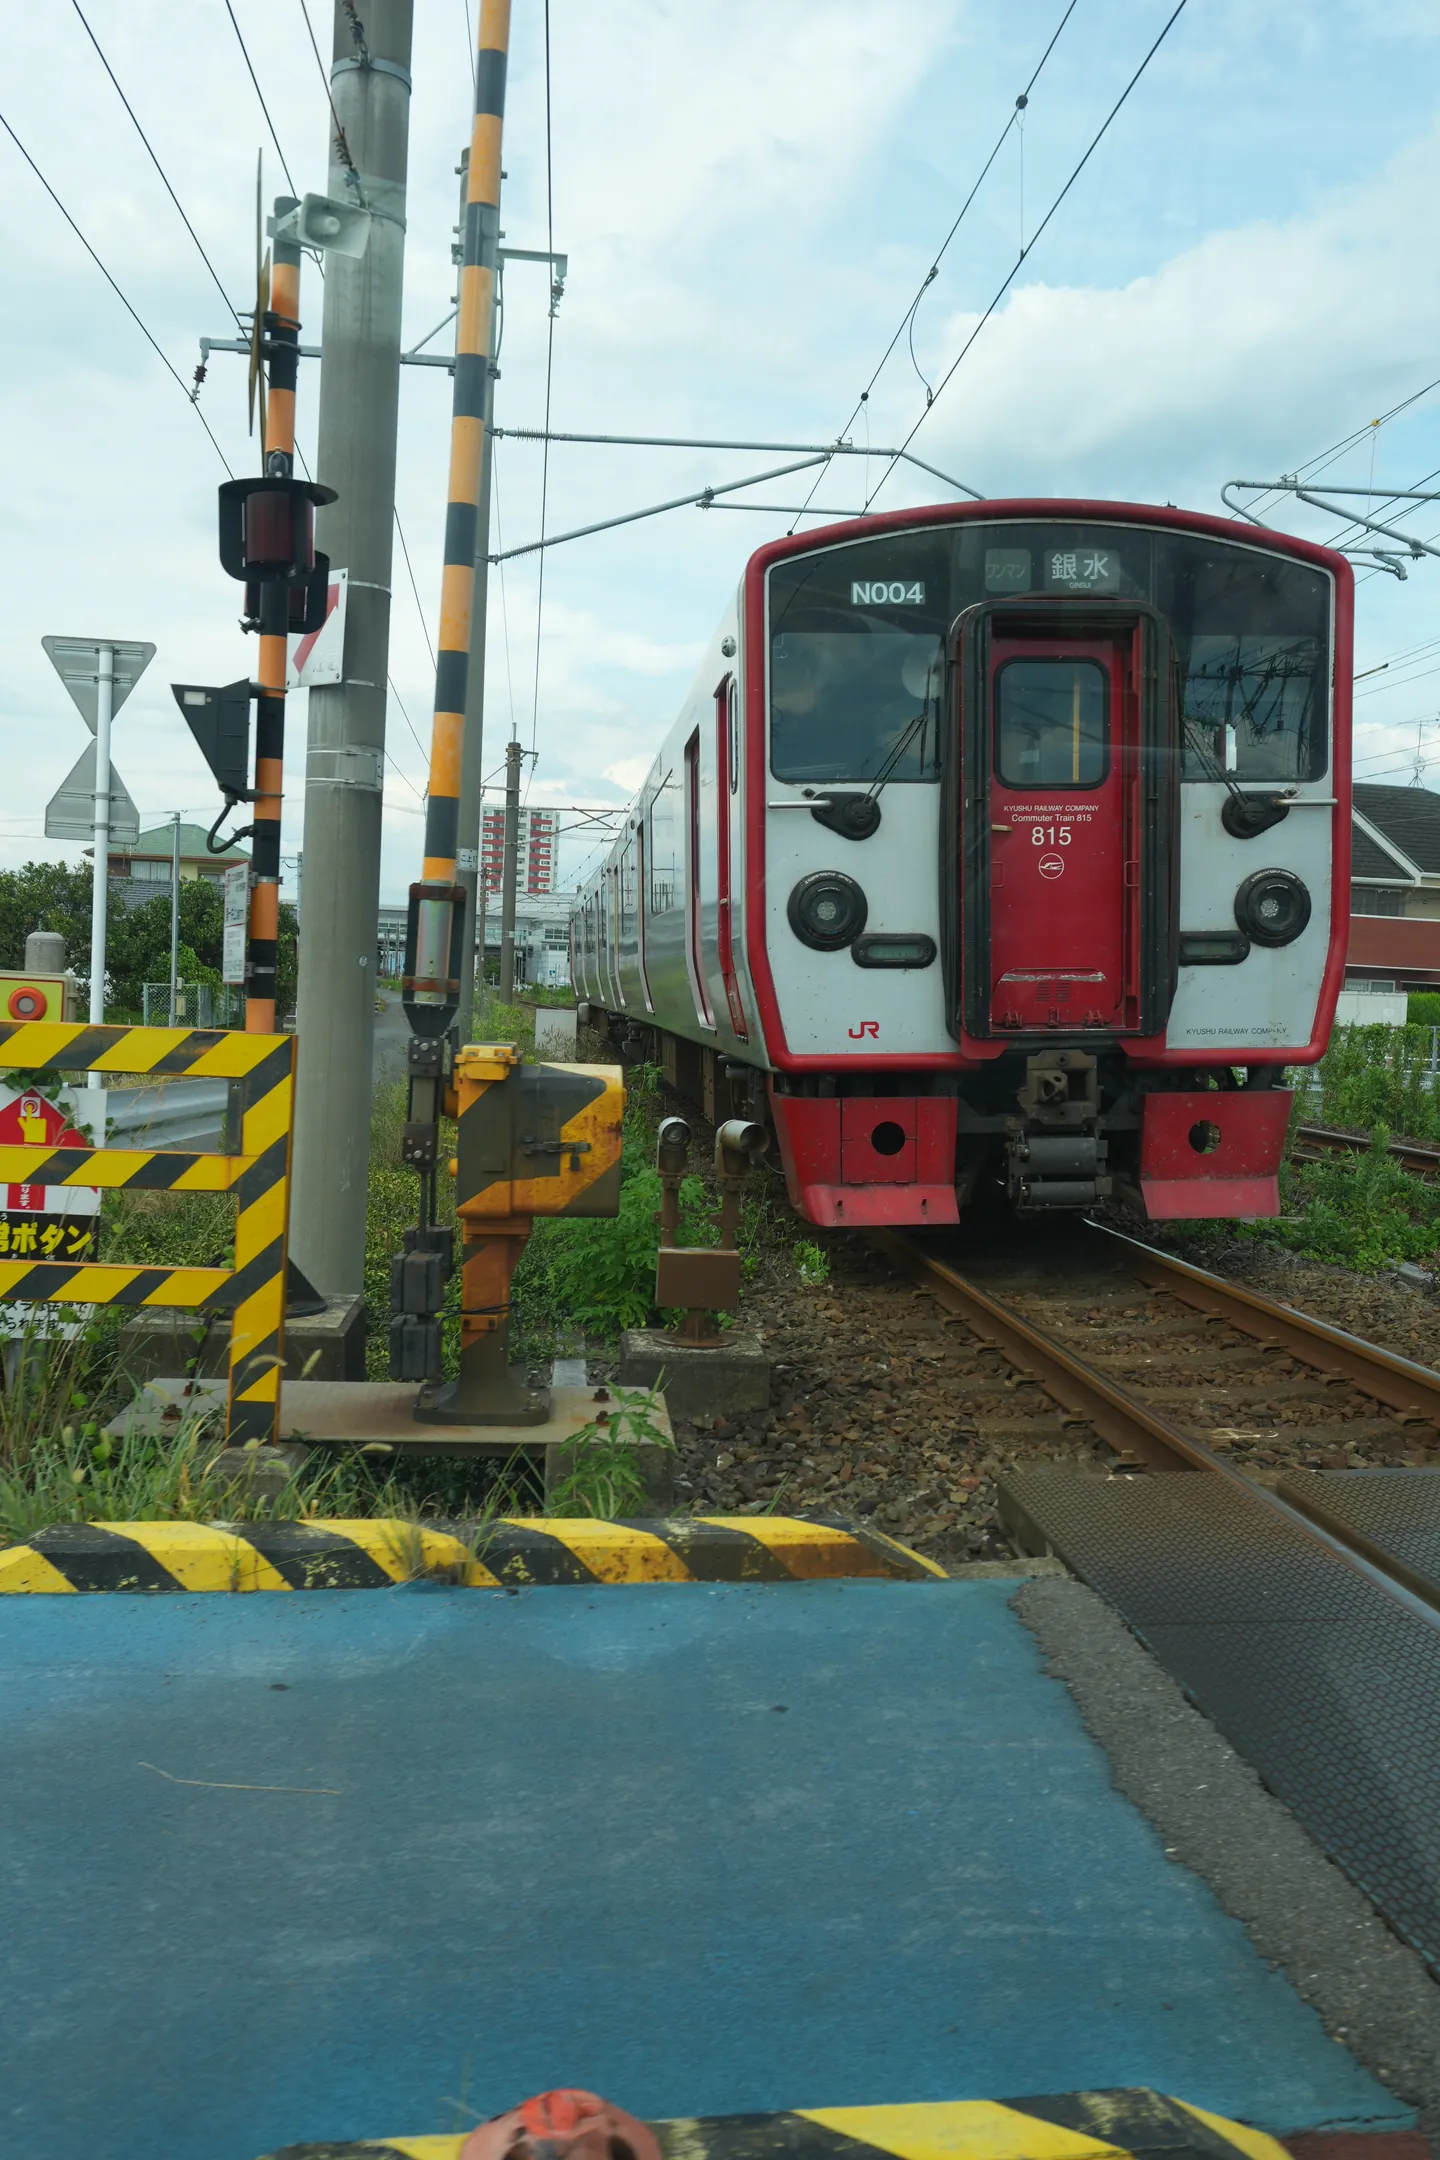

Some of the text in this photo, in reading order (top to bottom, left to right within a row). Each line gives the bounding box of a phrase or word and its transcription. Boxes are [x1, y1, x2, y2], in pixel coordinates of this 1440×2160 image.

[1051, 553, 1109, 580] 銀水
[852, 582, 924, 604] N004
[1011, 814, 1092, 822] Commuter Train 815
[1031, 826, 1072, 846] 815
[848, 1021, 880, 1040] JR
[1186, 1028, 1216, 1036] KYUSHU
[1218, 1027, 1250, 1036] RAILWAY
